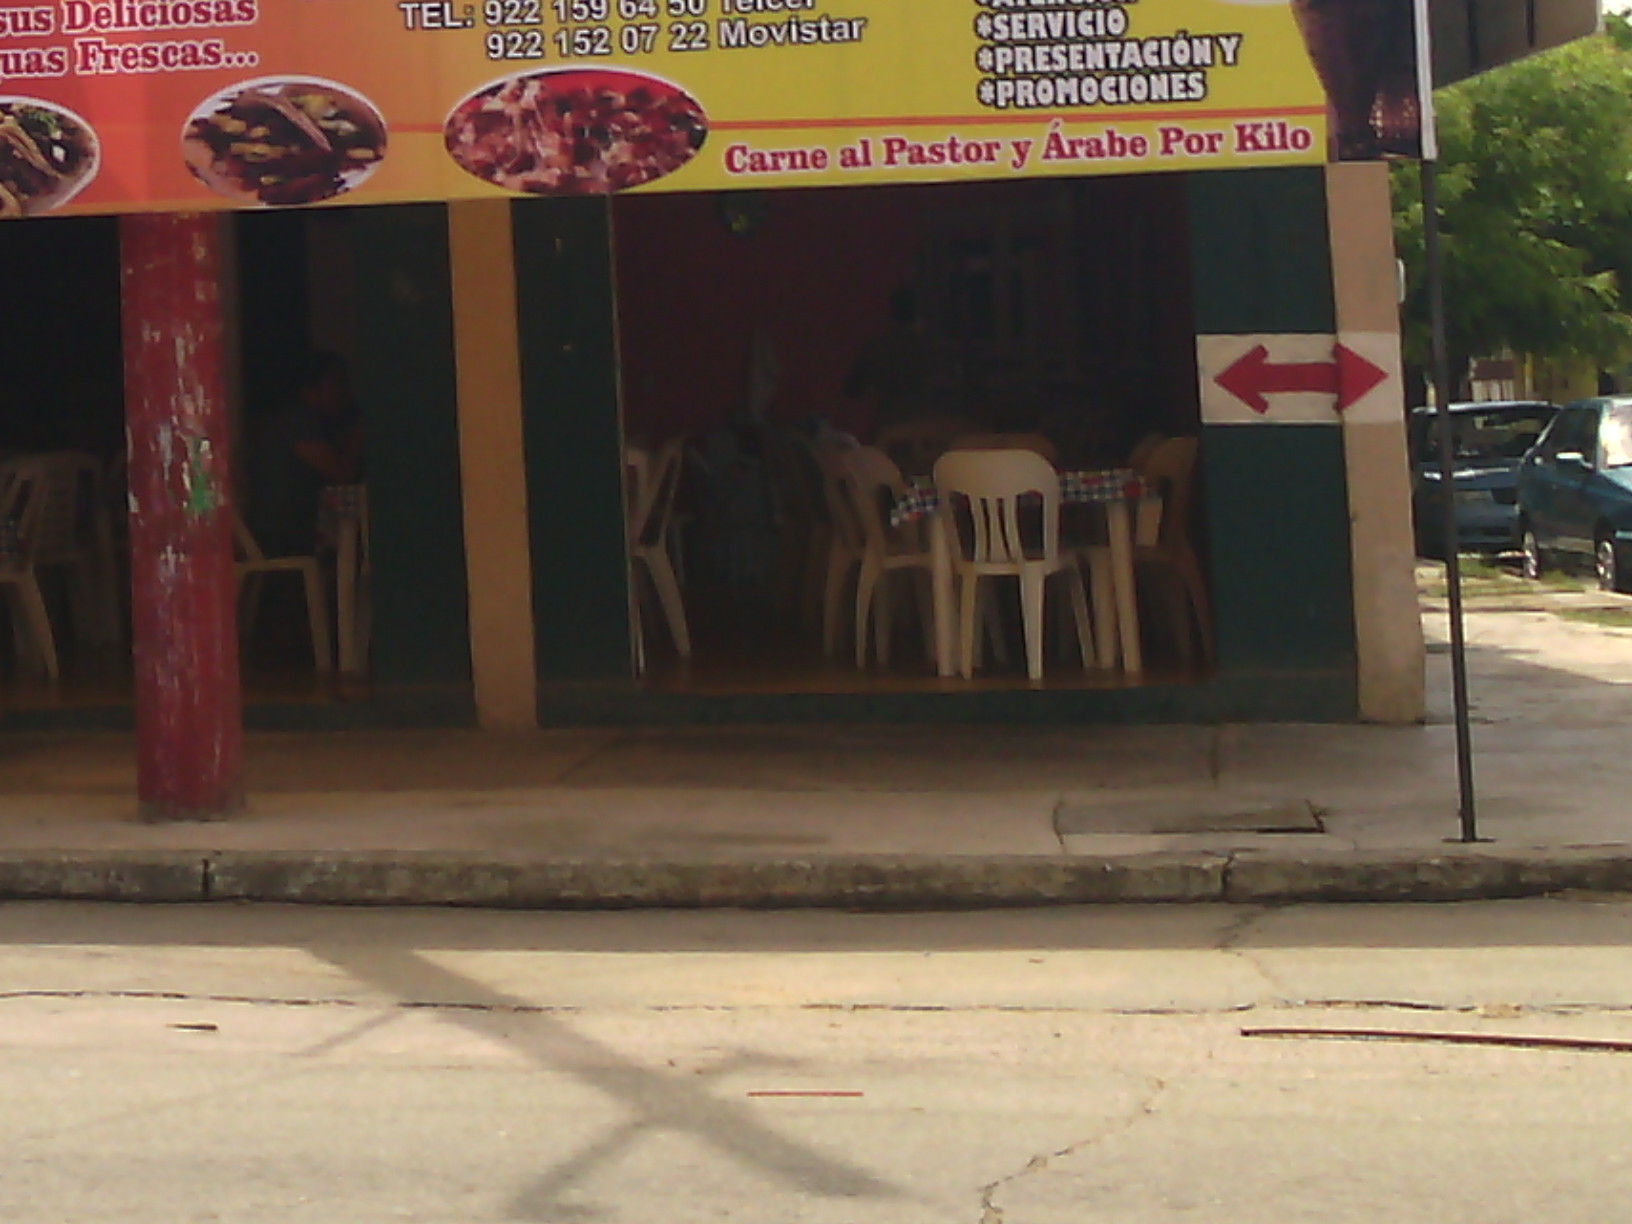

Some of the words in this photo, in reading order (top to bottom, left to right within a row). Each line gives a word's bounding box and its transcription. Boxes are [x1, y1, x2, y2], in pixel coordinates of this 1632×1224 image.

[400, 0, 473, 30] TEL:
[485, 30, 543, 61] 922
[553, 27, 611, 58] 152
[619, 24, 658, 55] 07
[667, 21, 709, 52] 22
[717, 14, 866, 51] Movistar
[1218, 33, 1242, 66] Y
[76, 38, 258, 74] Frescas...
[723, 143, 828, 175] Carne
[839, 138, 872, 169] al
[883, 135, 1000, 168] Pastor
[1011, 138, 1032, 170] y
[1041, 120, 1148, 161] Árabe
[1157, 126, 1224, 156] Por
[1235, 121, 1312, 153] Kilo
